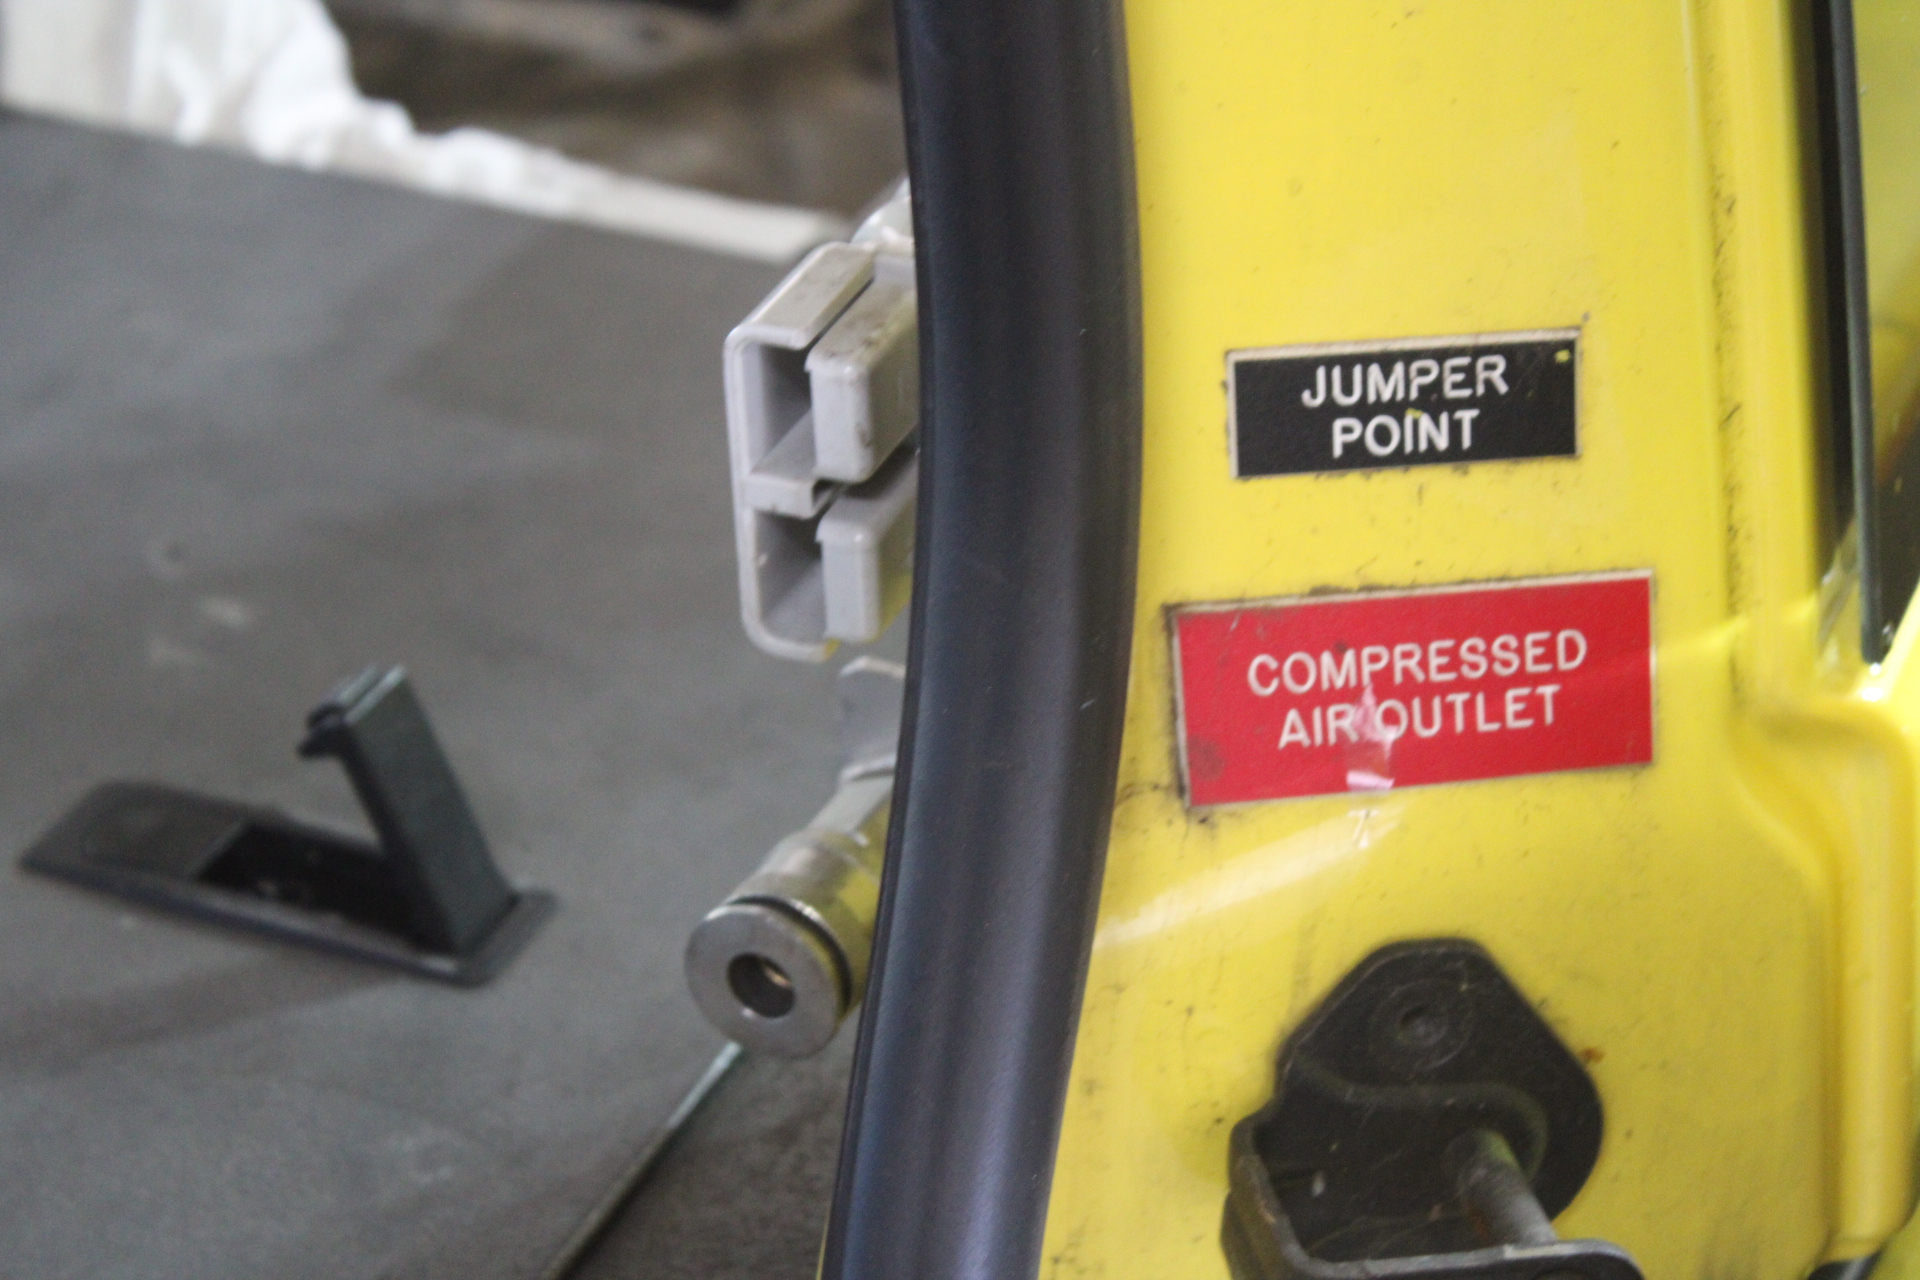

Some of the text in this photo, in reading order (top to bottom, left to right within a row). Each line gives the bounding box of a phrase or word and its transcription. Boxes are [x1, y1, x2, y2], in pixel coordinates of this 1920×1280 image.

[1302, 354, 1509, 408] JUMPER
[1332, 408, 1480, 459] POINT
[1247, 628, 1588, 696] COMPRESSED
[1278, 683, 1561, 750] AIR OUTLET
